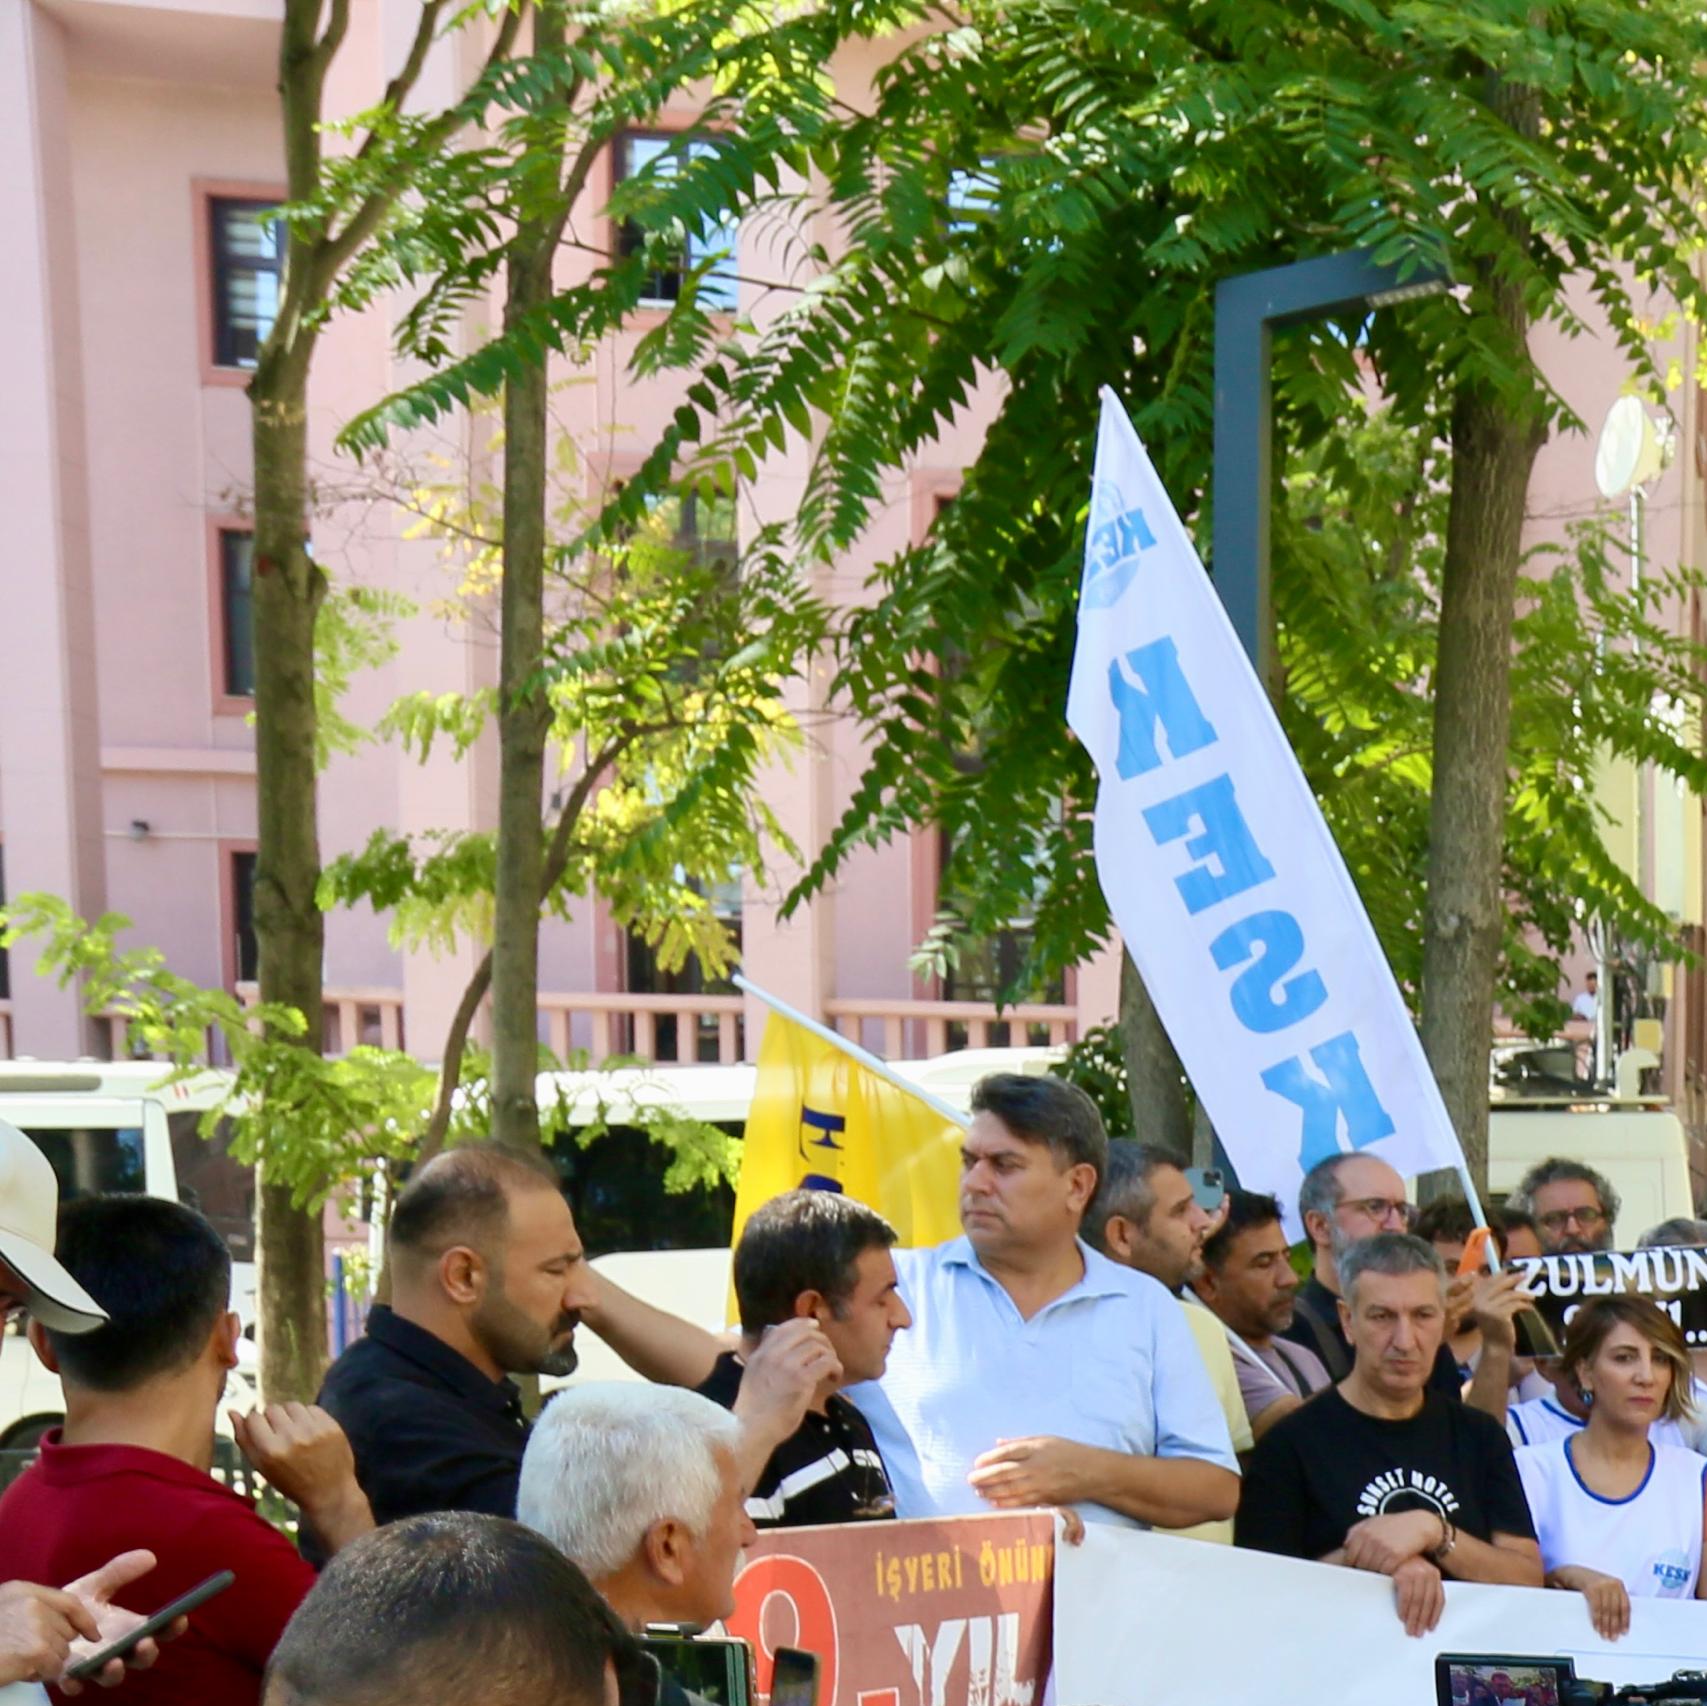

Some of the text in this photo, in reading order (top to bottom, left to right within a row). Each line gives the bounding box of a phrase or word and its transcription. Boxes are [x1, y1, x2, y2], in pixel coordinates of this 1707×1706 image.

[1357, 1468, 1460, 1517] SUNSET MOTEL
[874, 1546, 963, 1602] İŞYERİ
[1653, 1563, 1692, 1583] KESK
